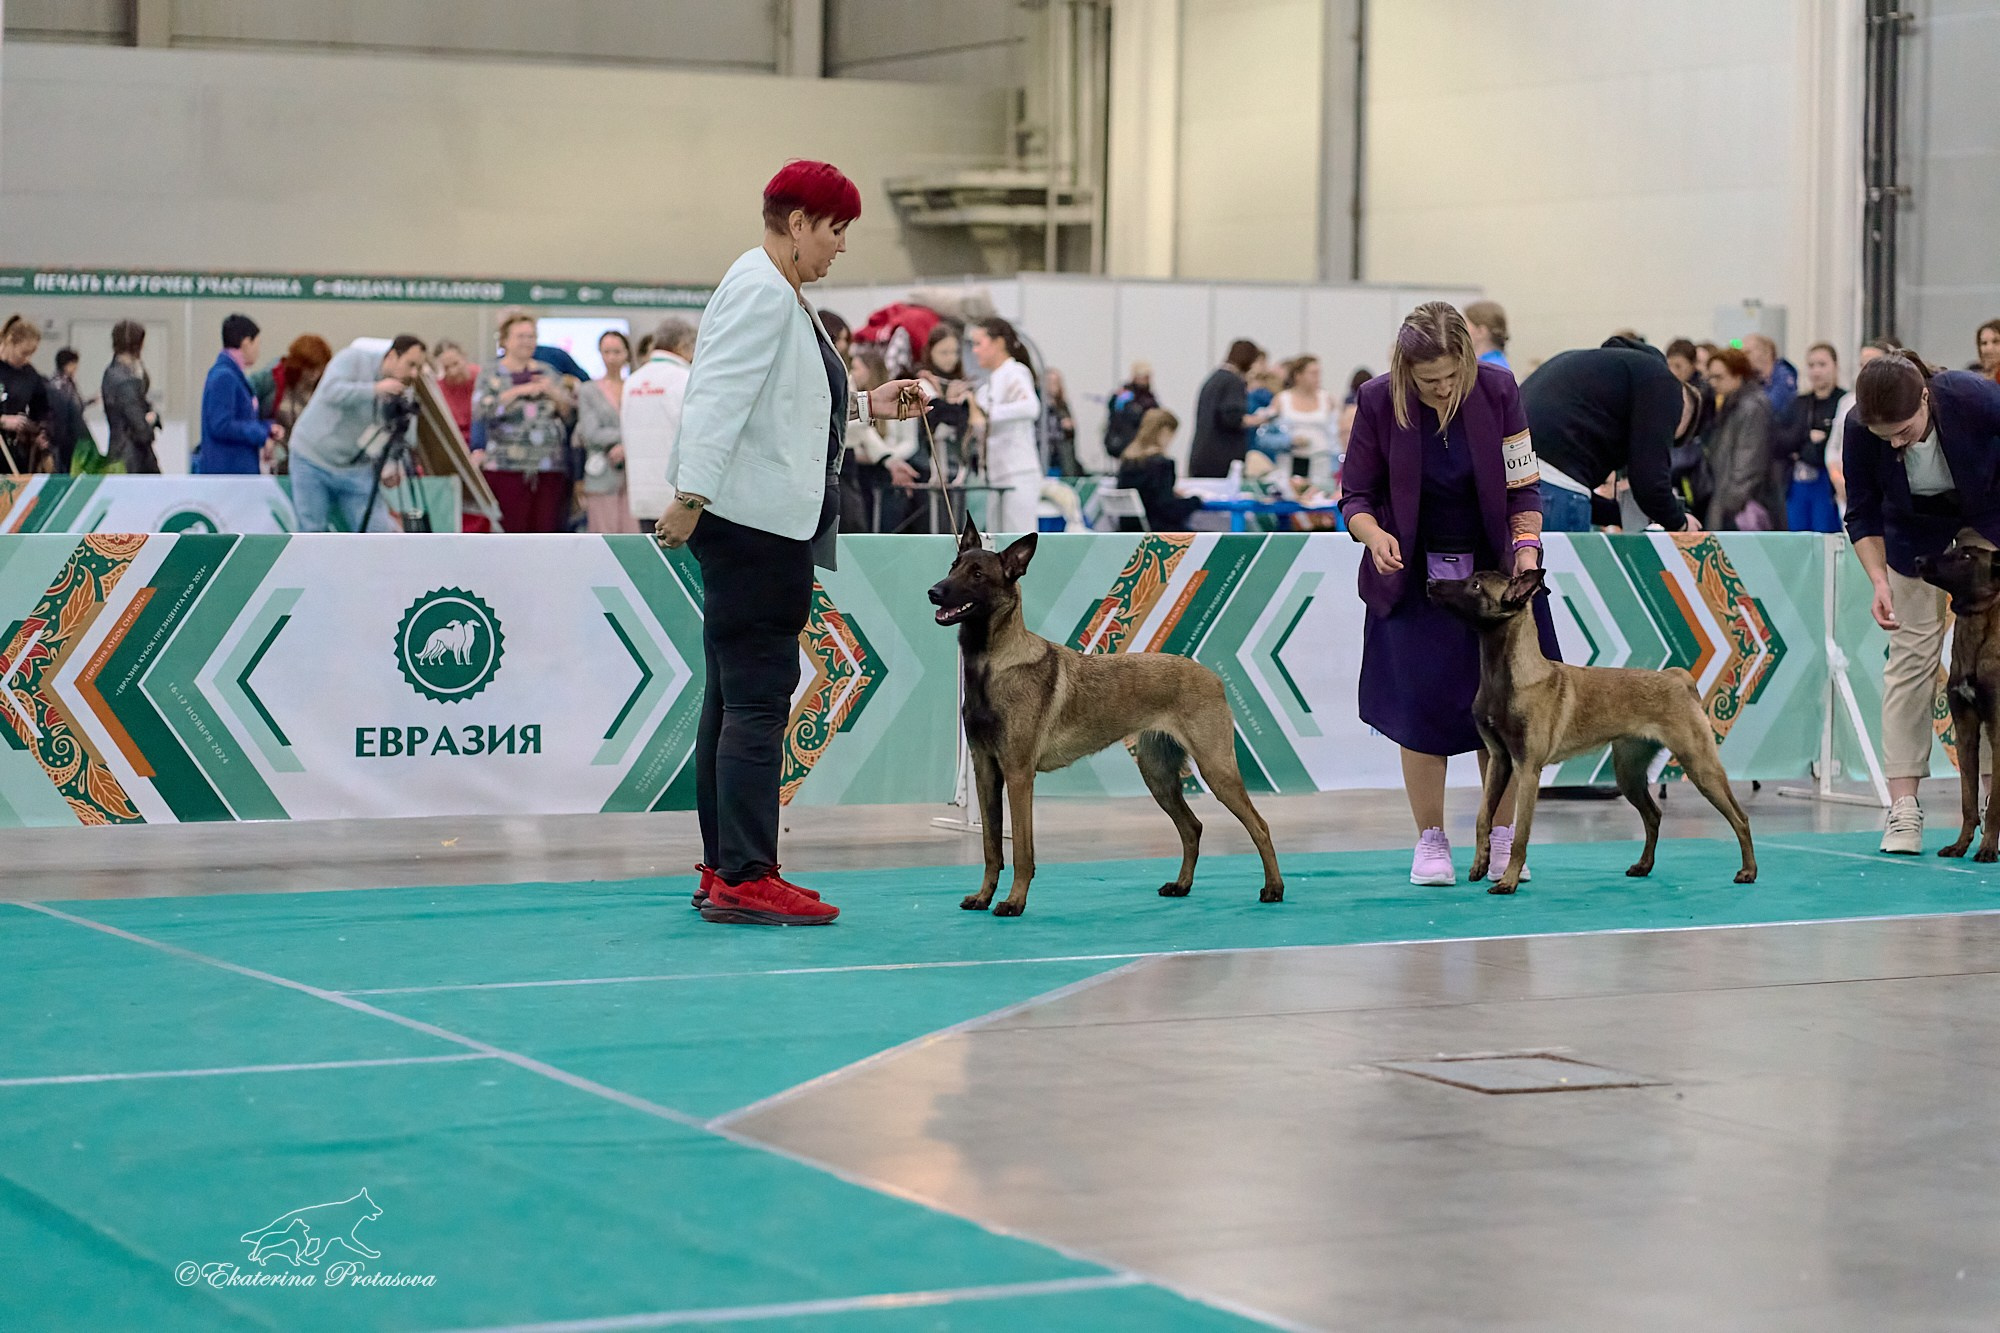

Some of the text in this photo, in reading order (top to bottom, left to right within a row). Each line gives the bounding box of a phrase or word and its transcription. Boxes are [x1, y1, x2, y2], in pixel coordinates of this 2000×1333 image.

[33, 273, 100, 292] ПЕЧАТЬ
[103, 275, 194, 293] КАРТОЧЕК
[106, 626, 123, 649] КУБОК
[122, 612, 133, 627] СНГ
[138, 639, 155, 663] КУБОК
[153, 597, 185, 640] ПРЕЗИДЕНТА
[183, 582, 194, 598] РКФ
[168, 681, 229, 764] 16-17 НОЯБРЯ 2024
[355, 724, 541, 757] ЕВРАЗИЯ
